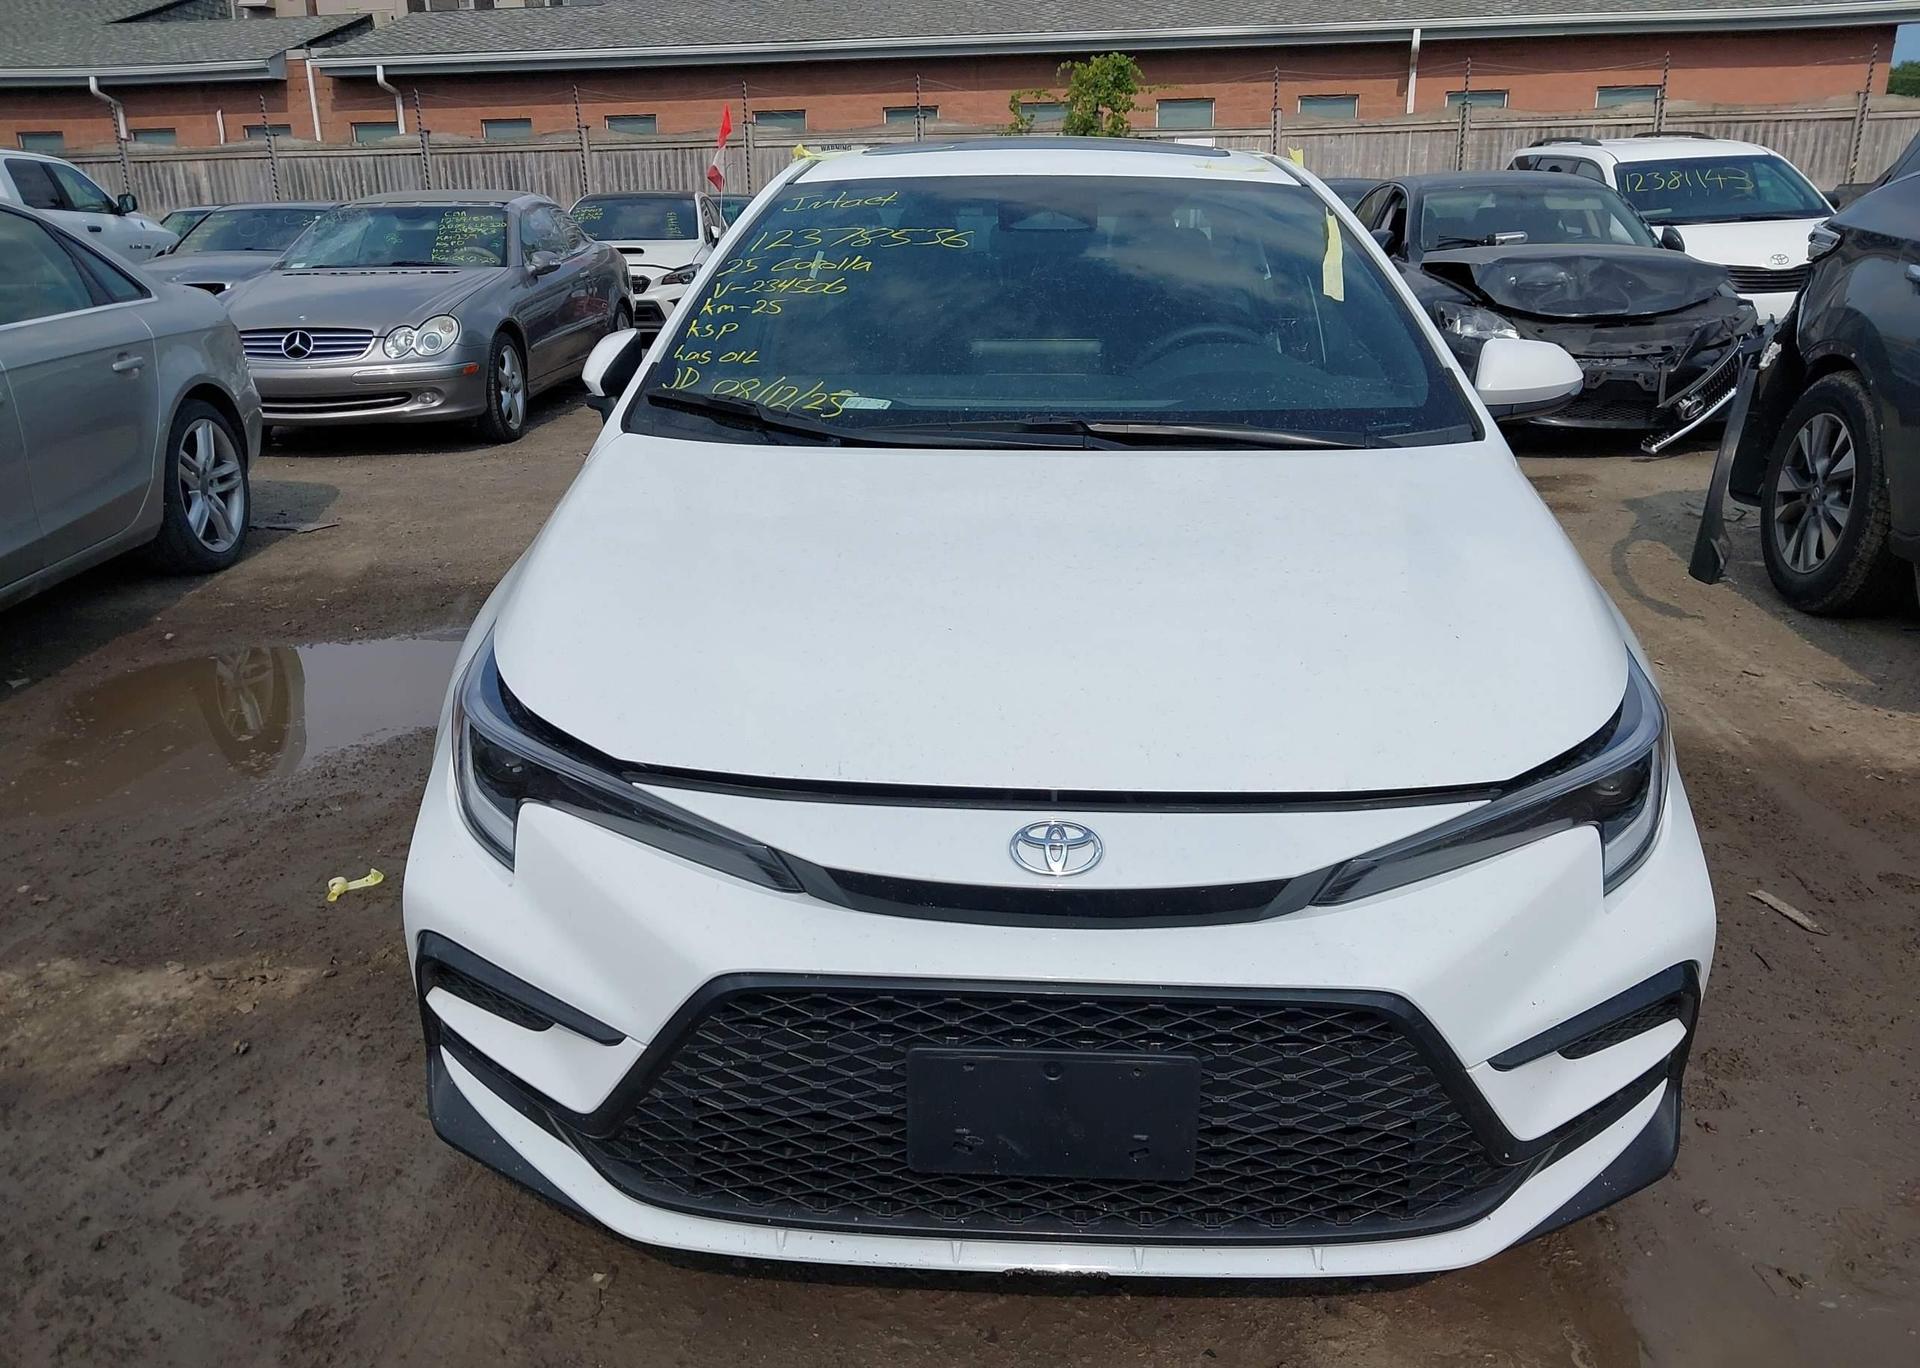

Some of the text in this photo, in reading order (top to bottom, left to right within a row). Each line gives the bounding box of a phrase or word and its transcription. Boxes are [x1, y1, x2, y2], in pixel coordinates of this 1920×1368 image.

[1626, 167, 1754, 193] 12381143
[751, 228, 975, 252] 12378536
[716, 255, 873, 277] 25 Corolla
